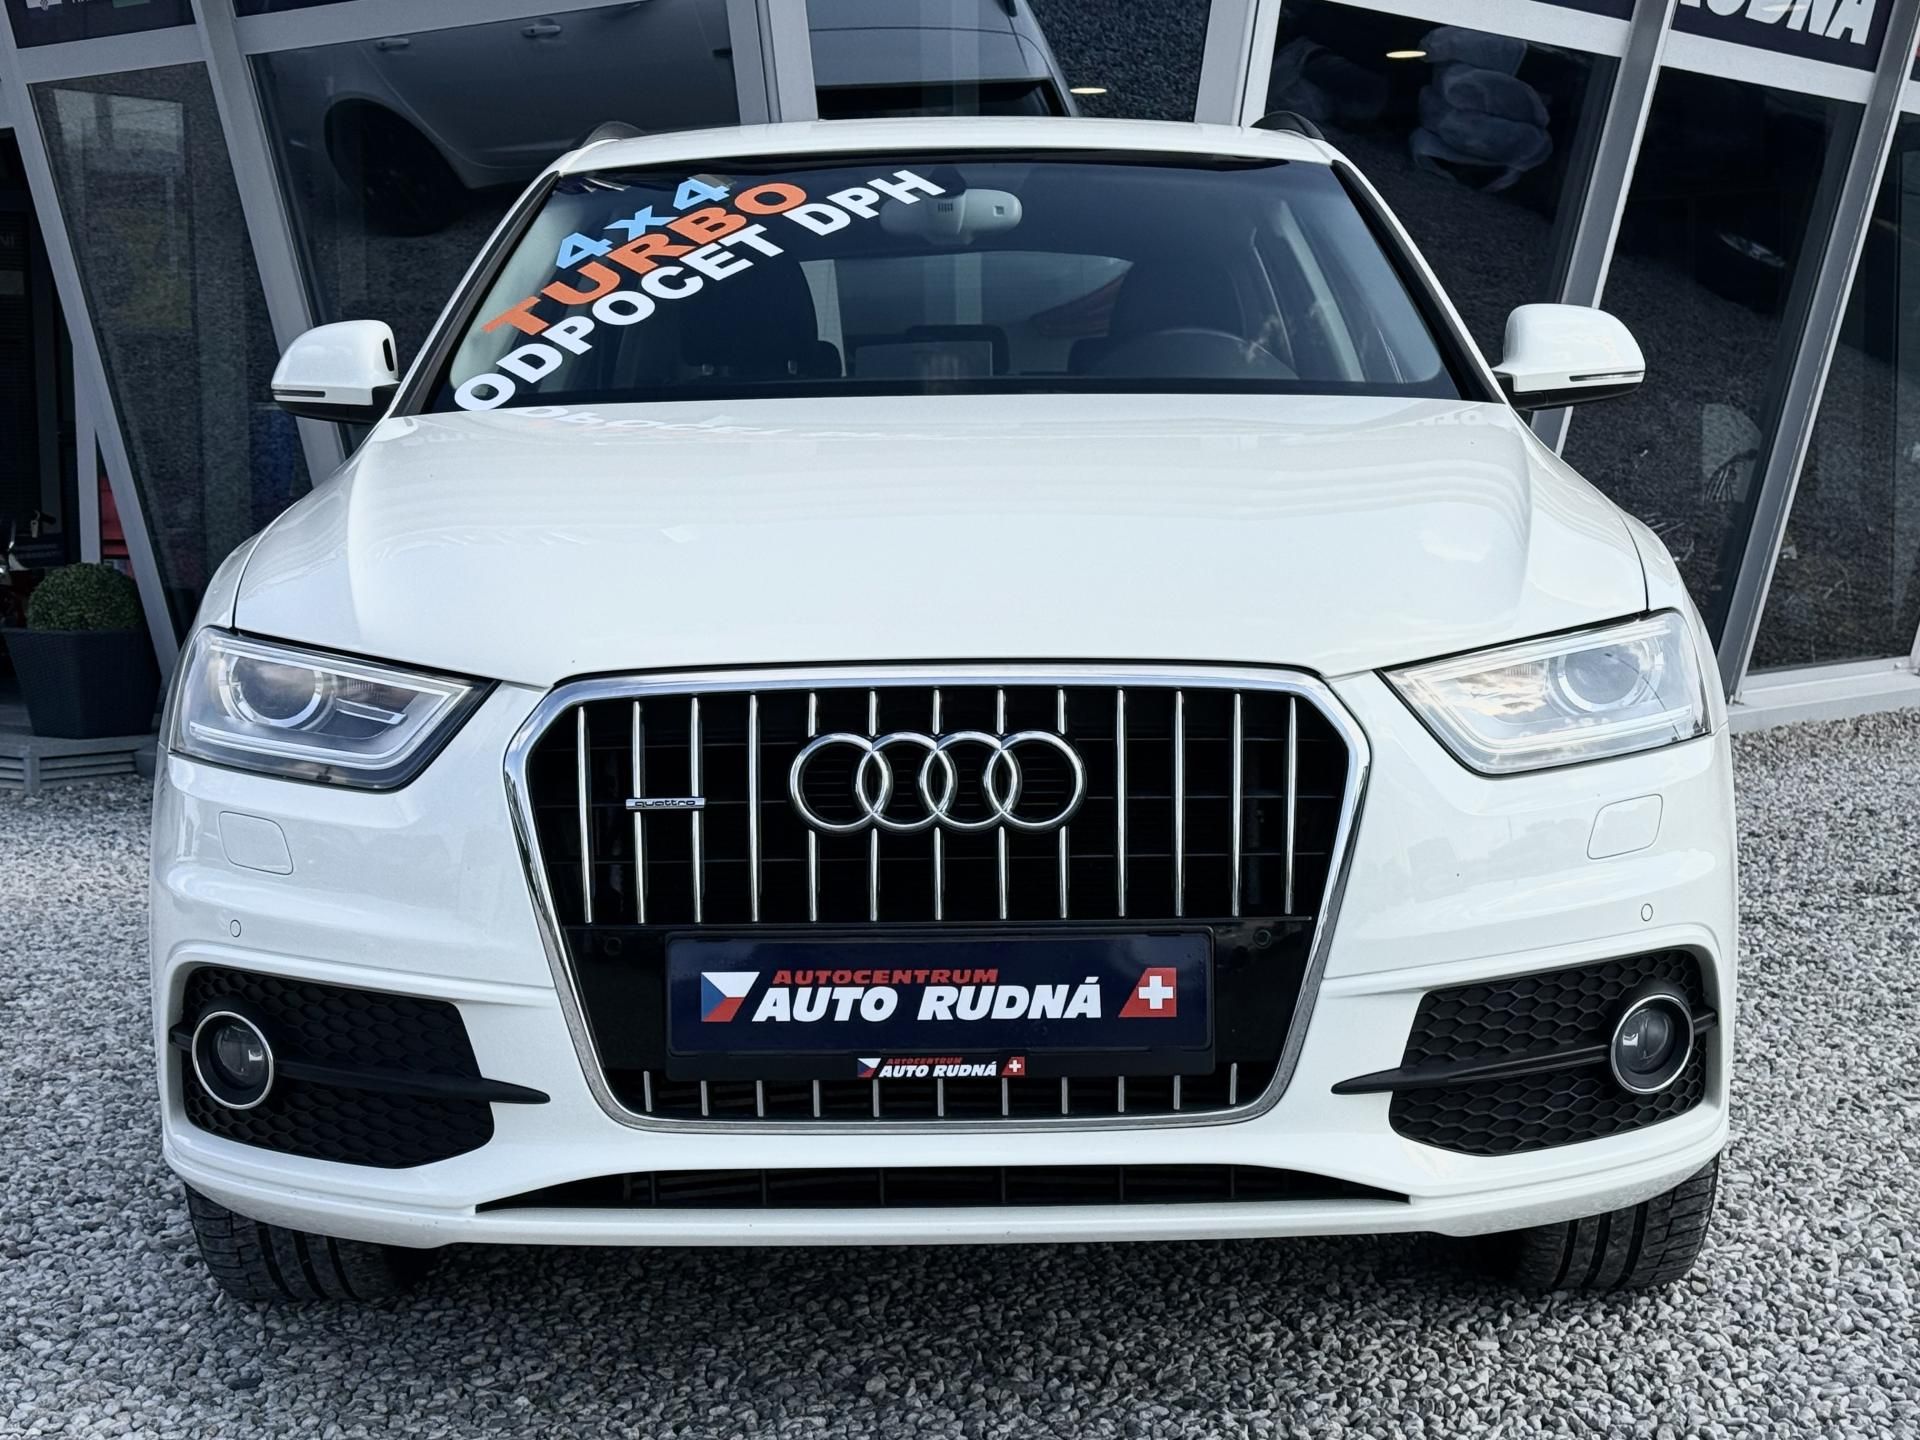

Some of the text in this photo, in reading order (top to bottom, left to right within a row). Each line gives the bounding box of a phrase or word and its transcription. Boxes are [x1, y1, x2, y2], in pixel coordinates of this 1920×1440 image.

[482, 183, 807, 335] TURBO
[454, 170, 946, 411] ODPOCET DPH
[634, 800, 696, 808] quattro
[772, 968, 999, 985] AUTOCENTRUM
[752, 977, 1102, 1022] AUTO RUDNÁ
[878, 1061, 997, 1078] AUTO RUDNÁ
[886, 1057, 963, 1065] AUTOCENTRUM
